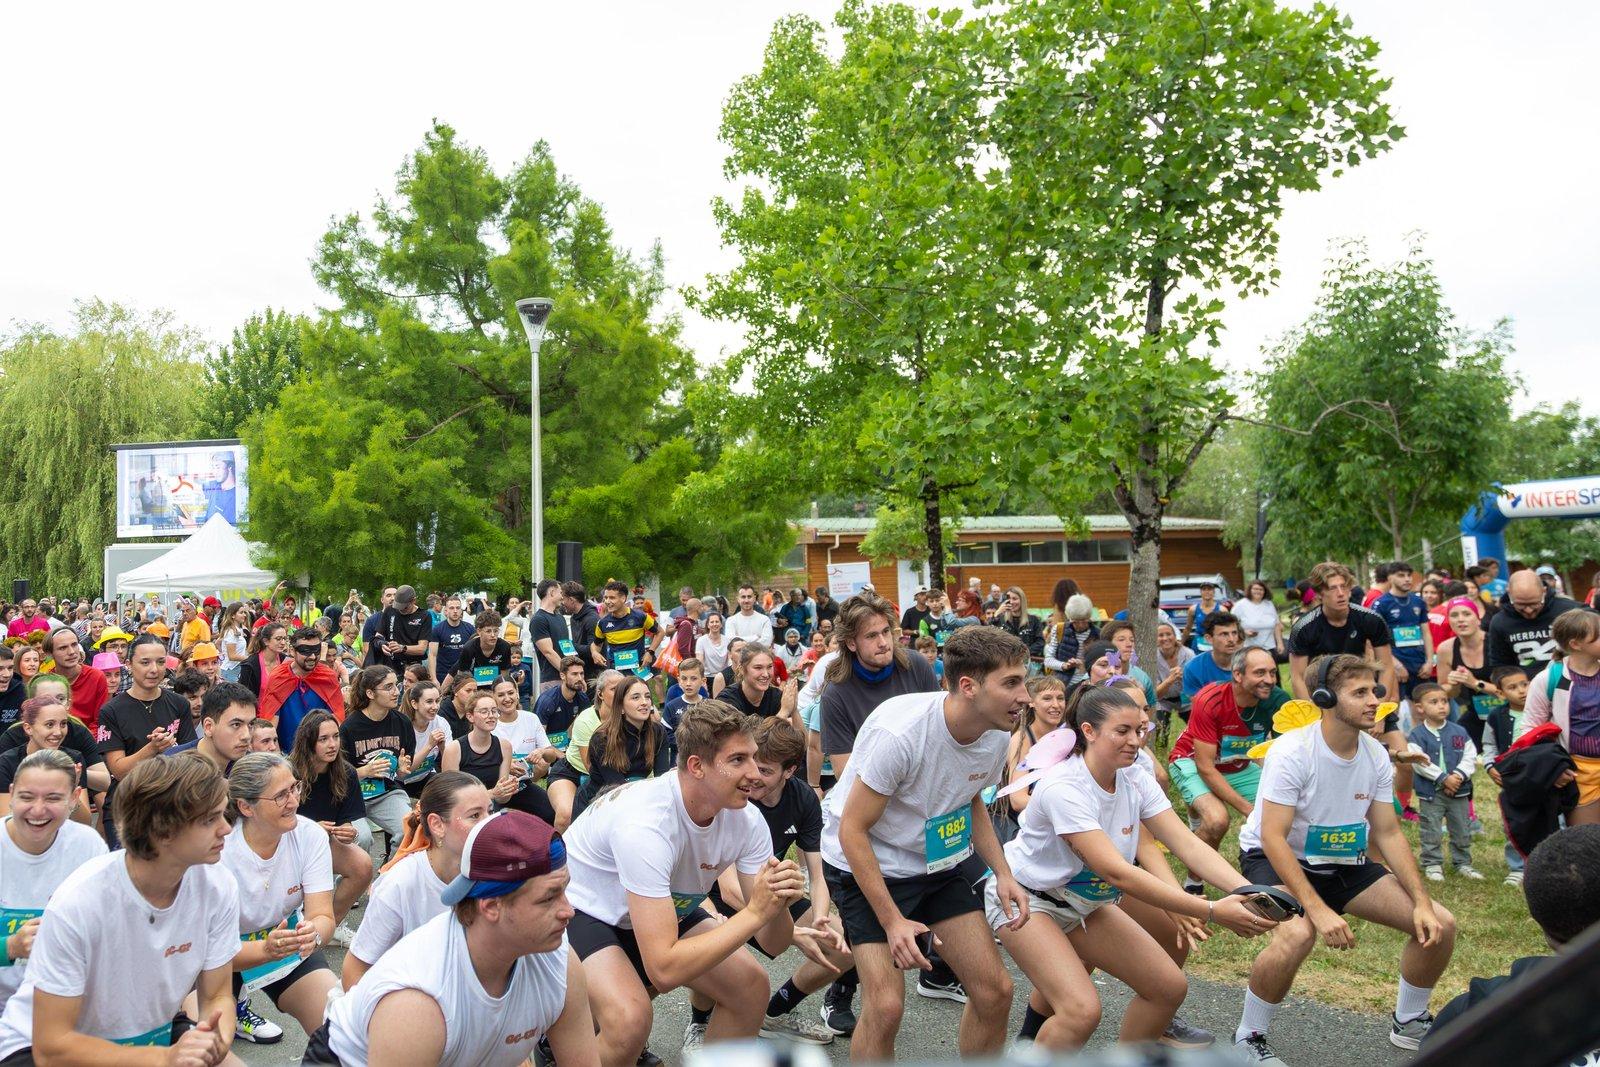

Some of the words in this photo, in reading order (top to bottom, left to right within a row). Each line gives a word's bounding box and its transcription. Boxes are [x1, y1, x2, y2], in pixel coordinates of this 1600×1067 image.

[450, 634, 461, 643] 25
[937, 816, 966, 840] 1882
[1321, 831, 1357, 844] 1632
